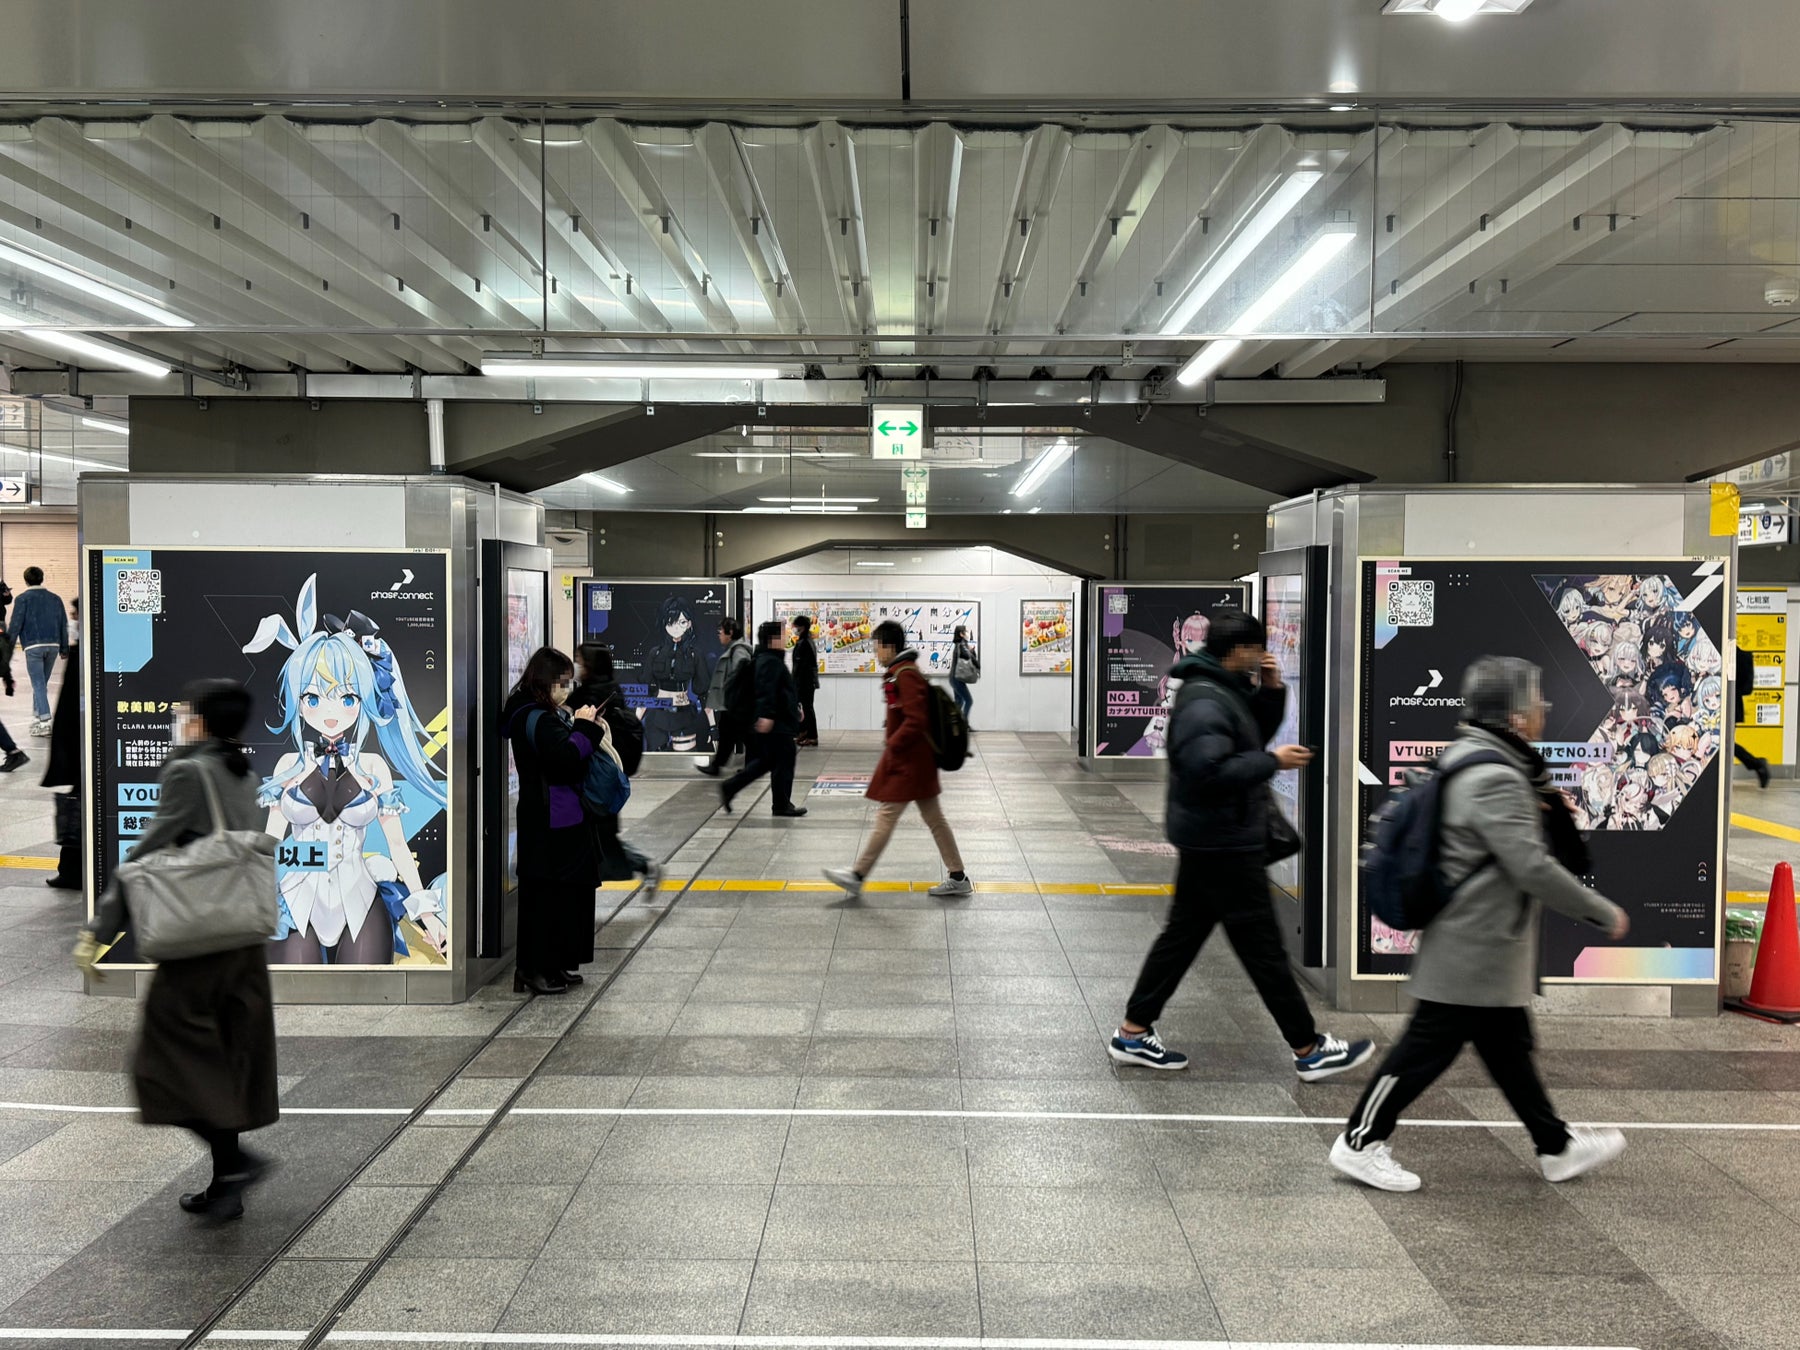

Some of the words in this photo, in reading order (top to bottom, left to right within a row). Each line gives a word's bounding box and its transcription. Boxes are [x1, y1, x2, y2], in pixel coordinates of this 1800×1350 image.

[1110, 693, 1136, 702] NO.1
[1395, 746, 1447, 756] VTUBE
[124, 788, 160, 800] YOU
[278, 846, 324, 867] 以上
